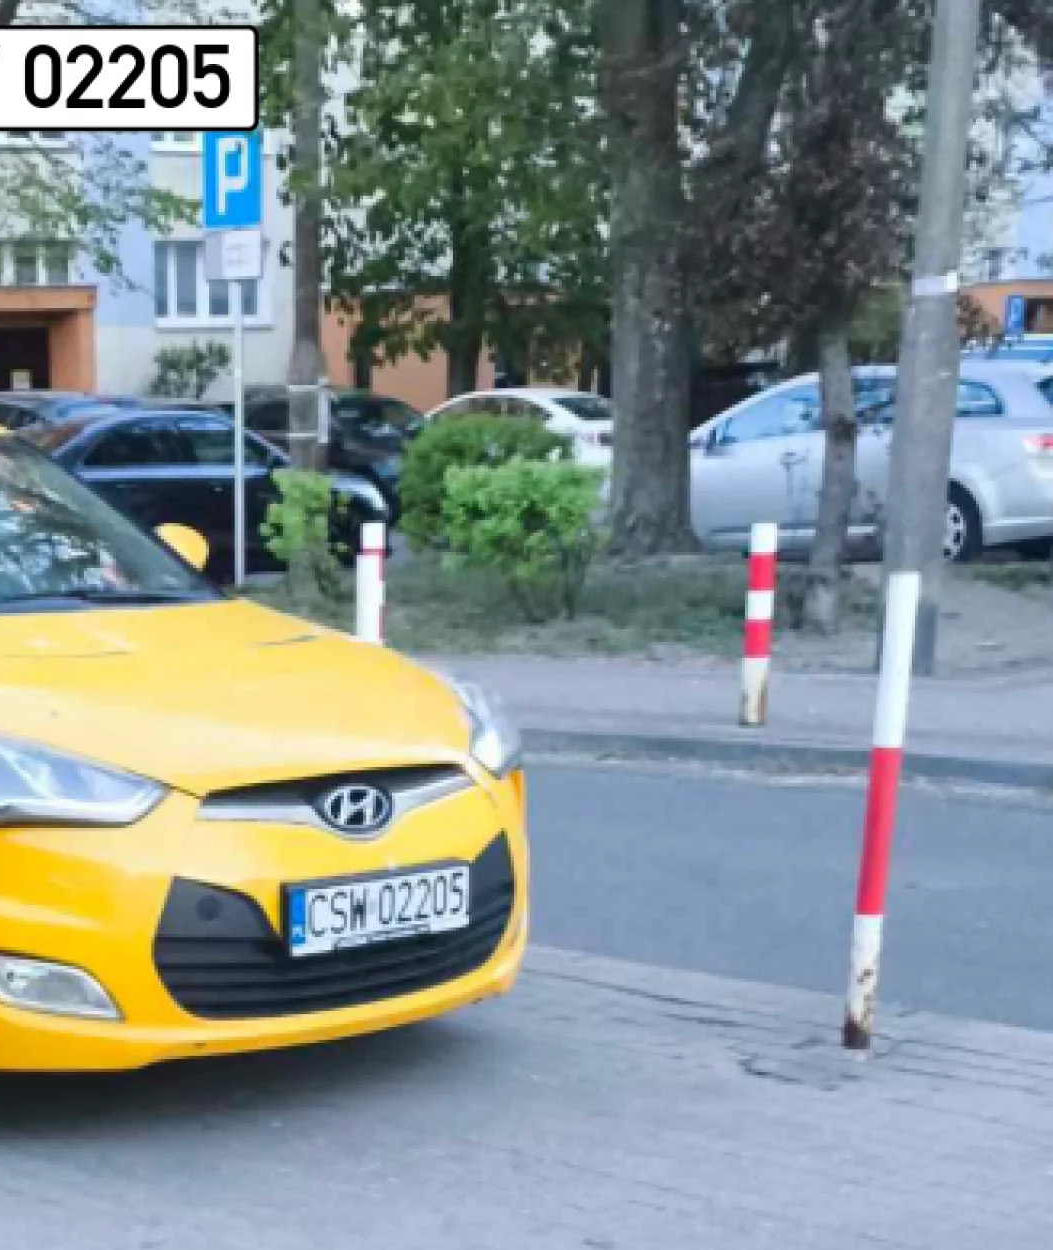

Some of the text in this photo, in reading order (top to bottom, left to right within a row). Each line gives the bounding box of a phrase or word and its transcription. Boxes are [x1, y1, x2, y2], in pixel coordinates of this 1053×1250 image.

[216, 137, 249, 216] P
[309, 872, 464, 938] CSW 02205
